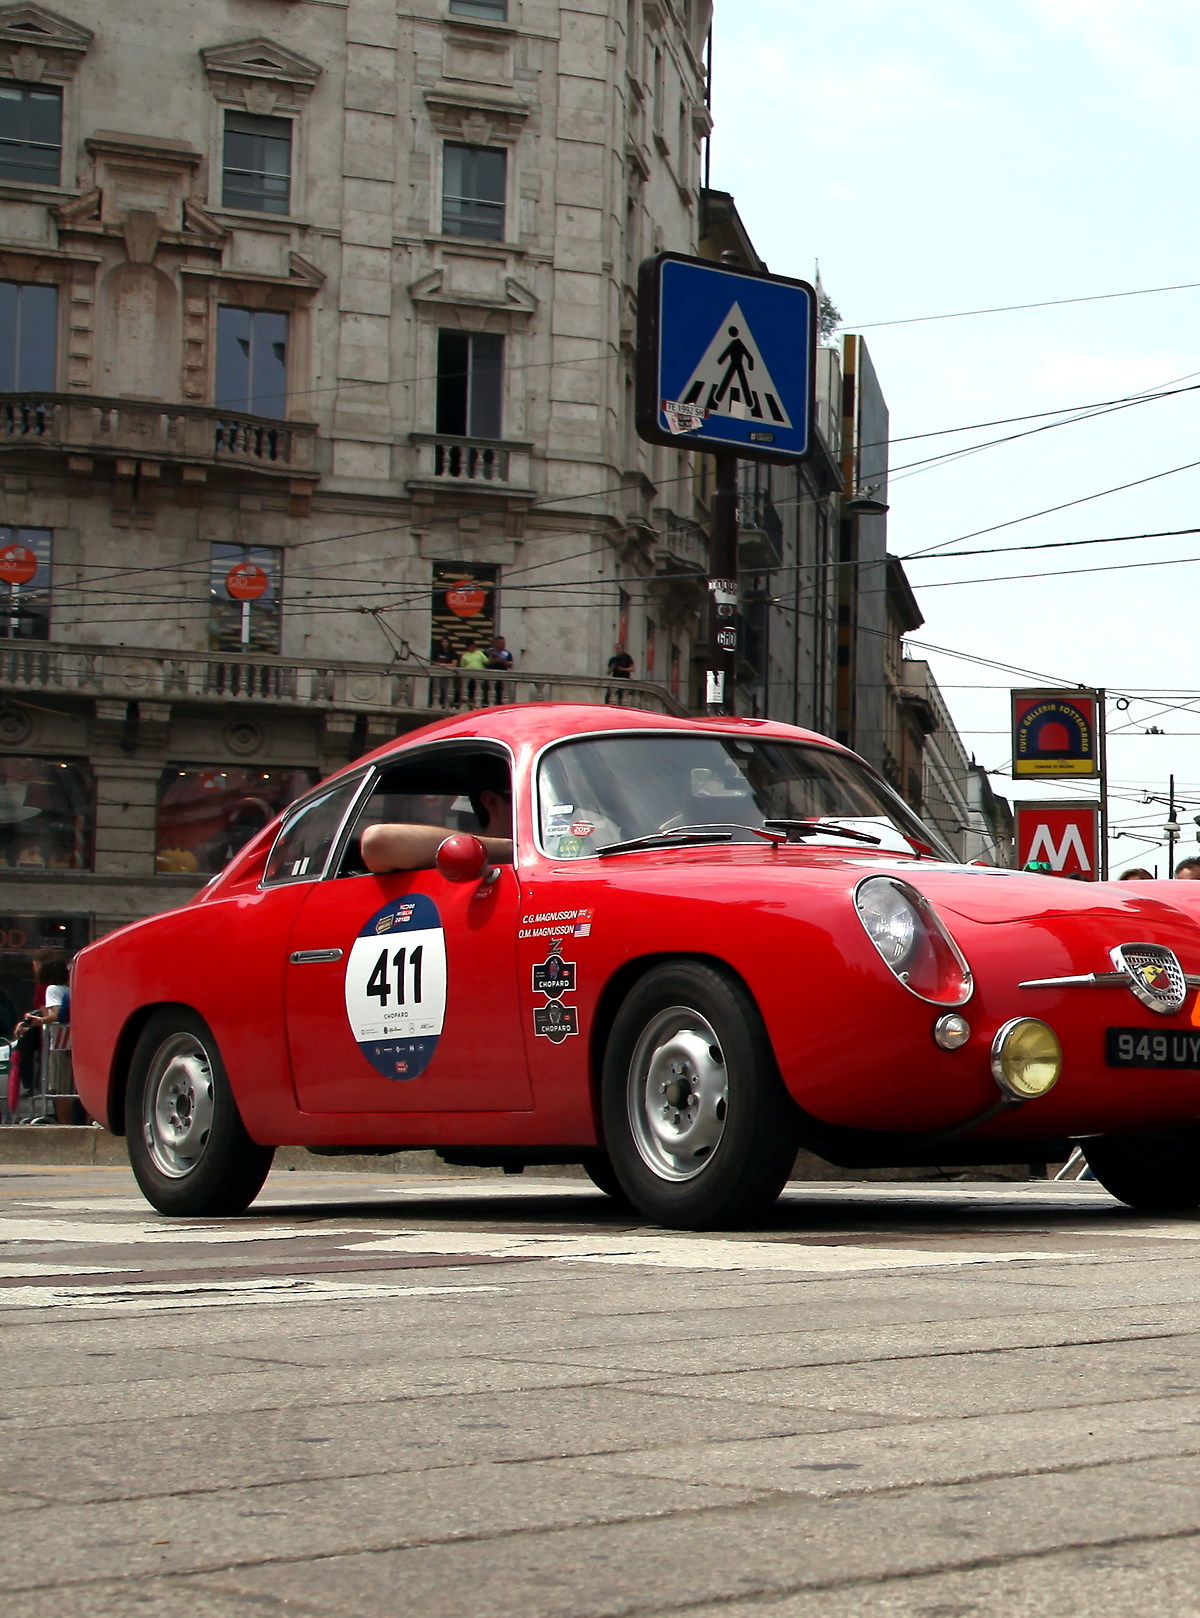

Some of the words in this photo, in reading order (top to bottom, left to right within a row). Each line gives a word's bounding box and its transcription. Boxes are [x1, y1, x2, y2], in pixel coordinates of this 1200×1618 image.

[1027, 823, 1091, 872] M
[535, 910, 578, 922] MAGNUSSON
[533, 925, 575, 937] MAGNUSSON
[366, 944, 424, 1007] 411
[538, 980, 570, 988] CHOPARD
[1118, 1034, 1168, 1062] 949
